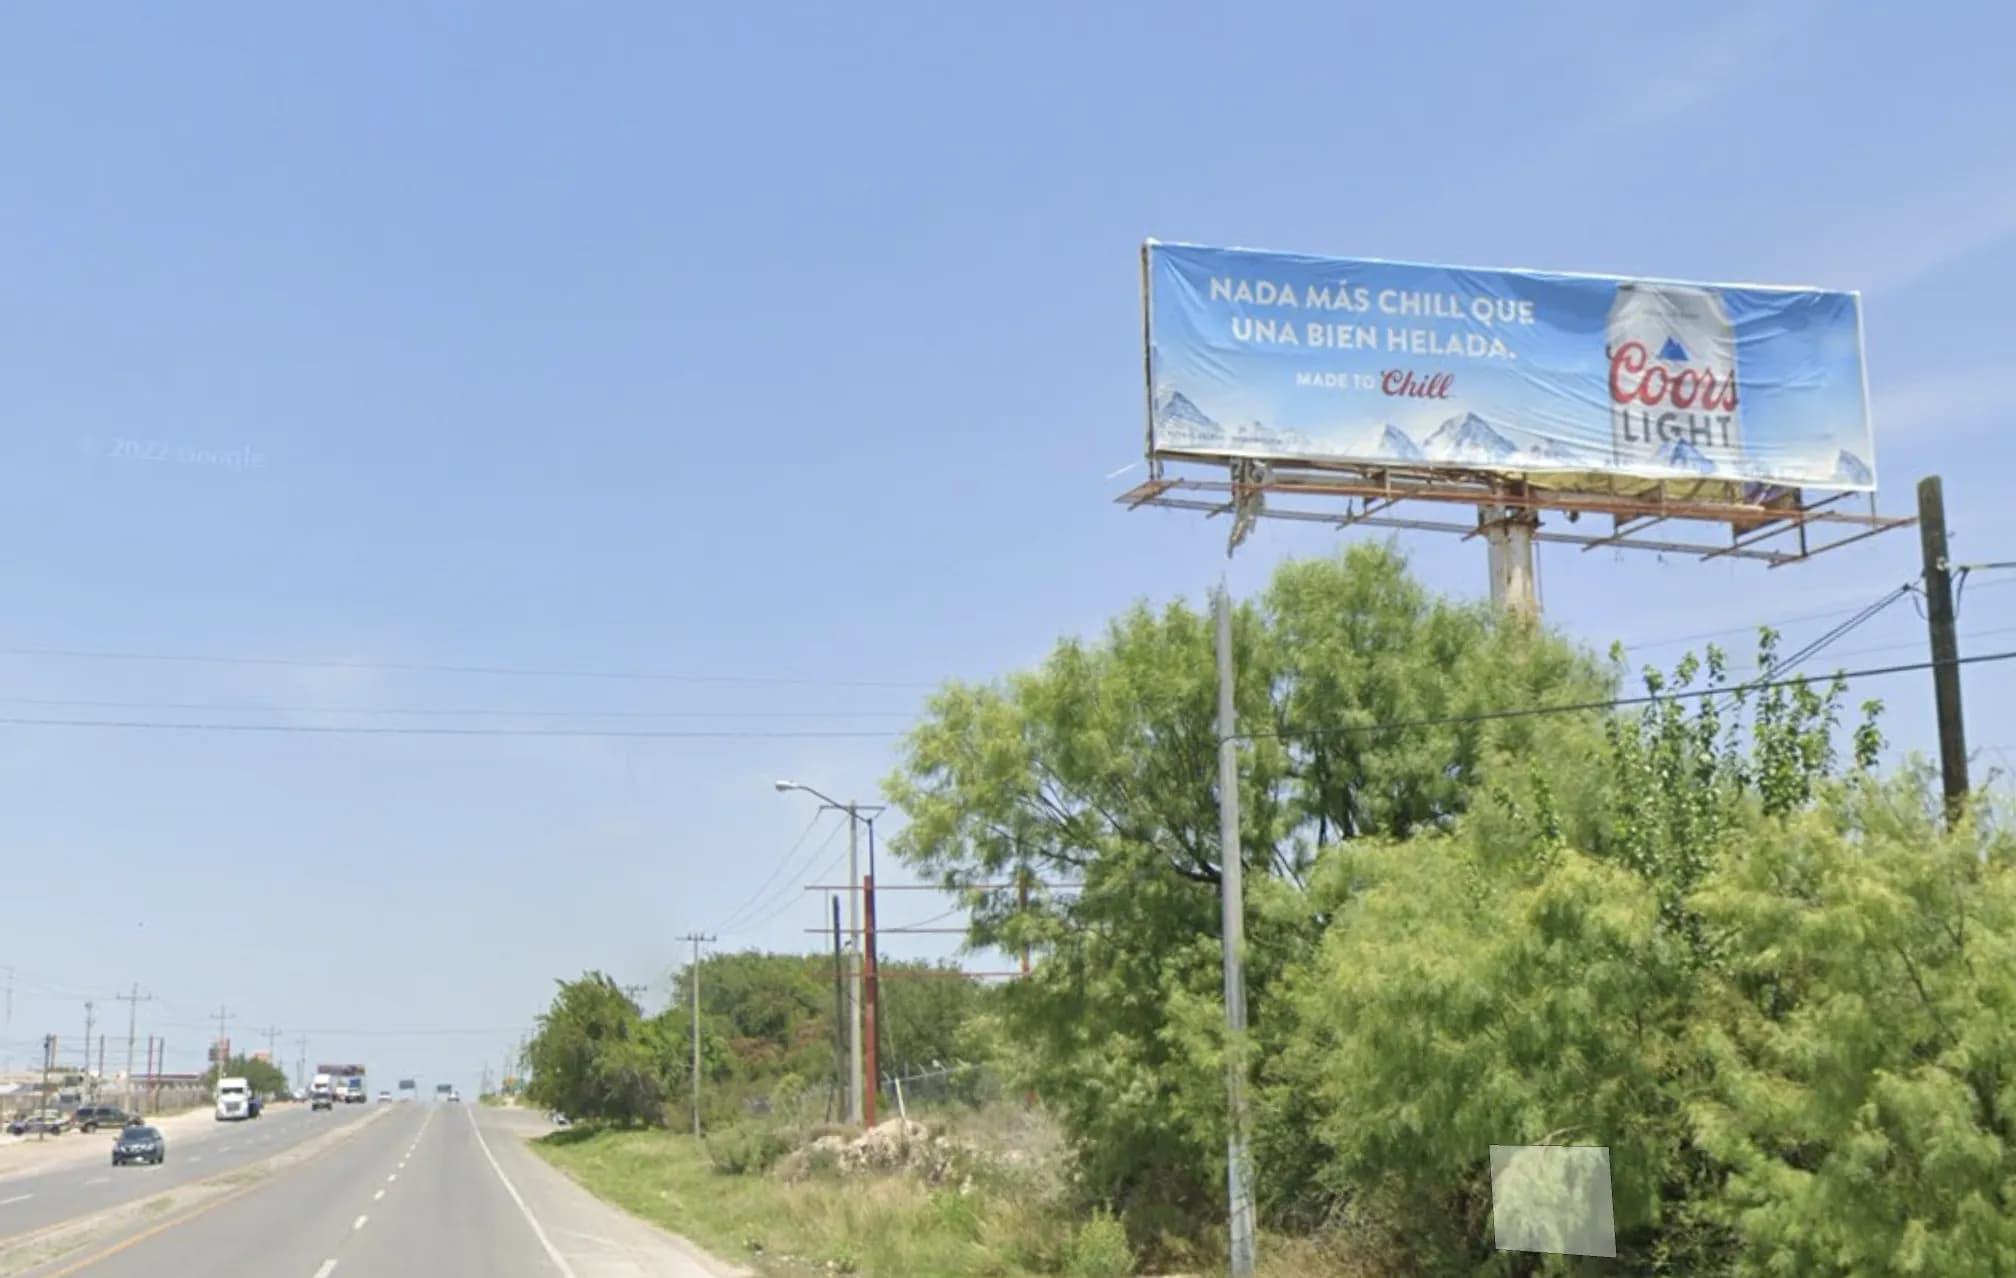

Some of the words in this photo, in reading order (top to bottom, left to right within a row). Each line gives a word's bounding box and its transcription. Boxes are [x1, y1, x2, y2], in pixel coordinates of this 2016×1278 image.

[1209, 276, 1298, 308] NADA
[1306, 279, 1370, 313] MÁS
[1378, 288, 1466, 319] CHILL
[1471, 297, 1536, 328] QUE
[1232, 316, 1299, 345] UNA
[1307, 322, 1378, 350] BIEN
[1387, 327, 1518, 360] HELADA.
[1296, 372, 1348, 389] MADE
[1353, 374, 1376, 390] TO
[1380, 369, 1456, 400] Chill
[1606, 341, 1739, 412] Coors
[1622, 410, 1732, 448] LIGHT
